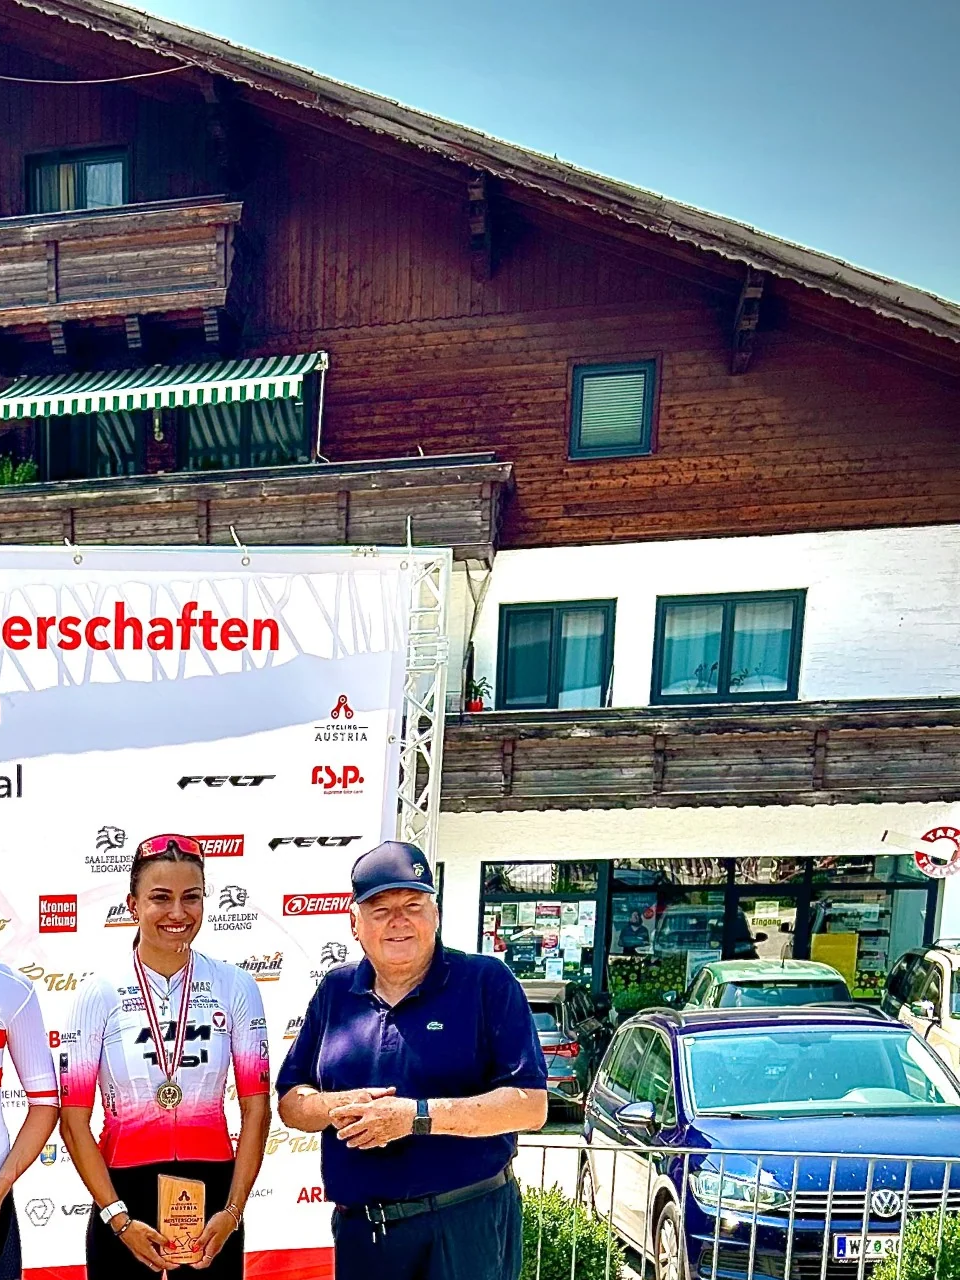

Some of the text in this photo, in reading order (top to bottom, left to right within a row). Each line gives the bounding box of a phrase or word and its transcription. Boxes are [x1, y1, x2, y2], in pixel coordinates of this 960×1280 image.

[314, 732, 368, 742] AUSTRIA
[177, 774, 276, 790] FELT
[268, 835, 363, 851] FELT
[40, 901, 76, 913] Kronen
[40, 914, 76, 927] Zeitung
[208, 913, 258, 923] SAALFELDEN
[751, 917, 782, 927] Eingang
[214, 922, 252, 931] LEOGANG
